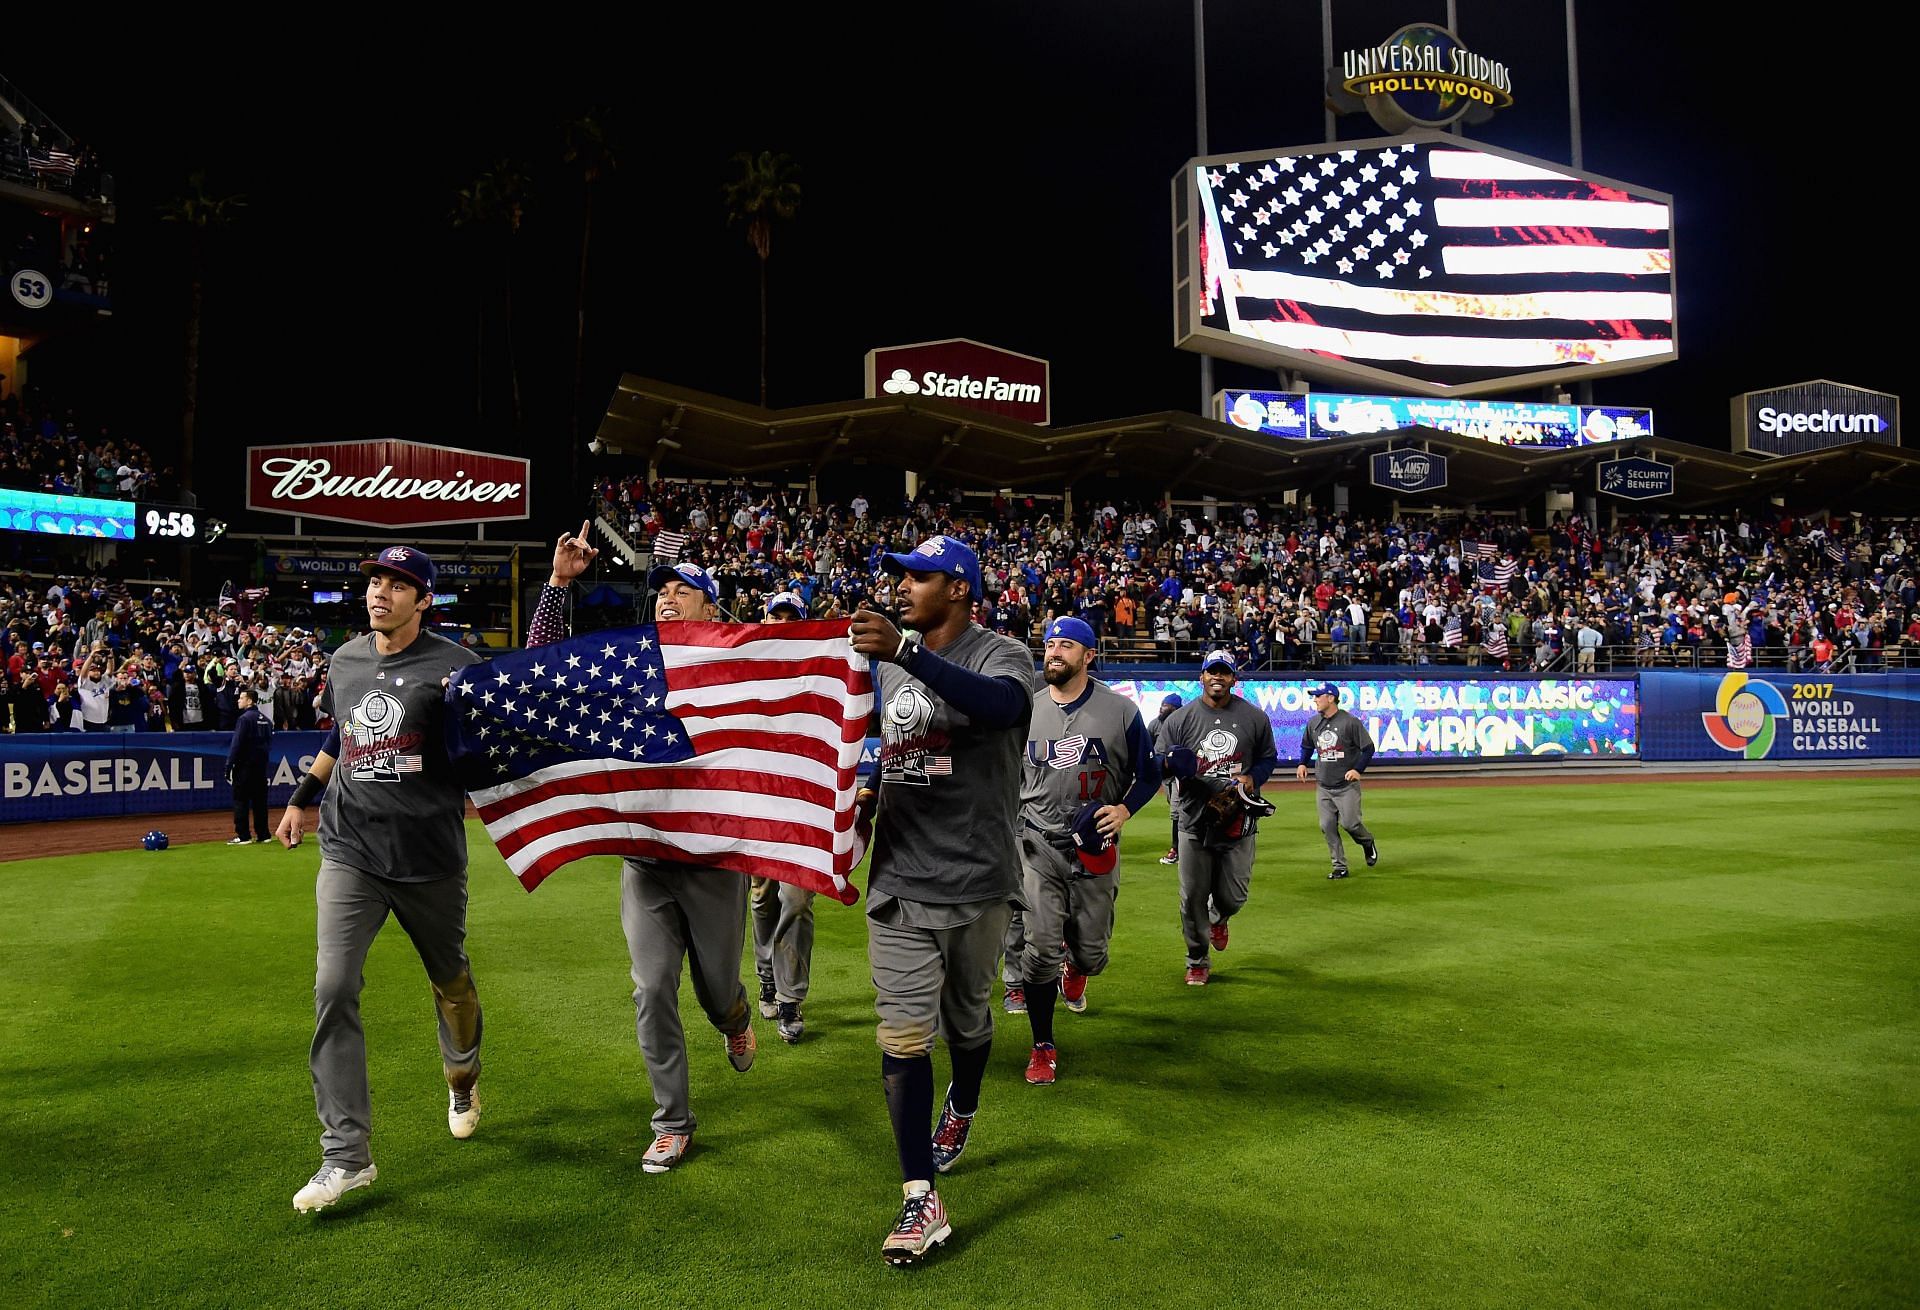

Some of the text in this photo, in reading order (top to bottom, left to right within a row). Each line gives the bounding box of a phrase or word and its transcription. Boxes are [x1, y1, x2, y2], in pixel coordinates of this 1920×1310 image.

[1343, 44, 1512, 94] UNIVERSAL STUDIOS
[1369, 77, 1495, 105] HOLLYWOOD
[19, 277, 45, 299] 53
[1758, 407, 1880, 438] Spectrum
[261, 457, 522, 503] Budweiser
[1389, 455, 1404, 479] LA
[1627, 469, 1670, 480] SECURITY
[1627, 480, 1664, 489] BENEFIT
[146, 510, 196, 538] 9:58
[299, 560, 347, 572] WORLD
[469, 565, 500, 575] 2017
[1255, 685, 1594, 711] WORD BASEBALL CLASSIC
[1791, 683, 1834, 699] 2017
[1791, 701, 1855, 716] WORLD
[1369, 716, 1534, 752] AMPION
[1792, 718, 1881, 733] BASEBALL
[1026, 734, 1110, 770] USA
[1792, 735, 1868, 750] CLASSIC
[4, 757, 214, 798] BASEBALL
[1078, 769, 1107, 801] 17
